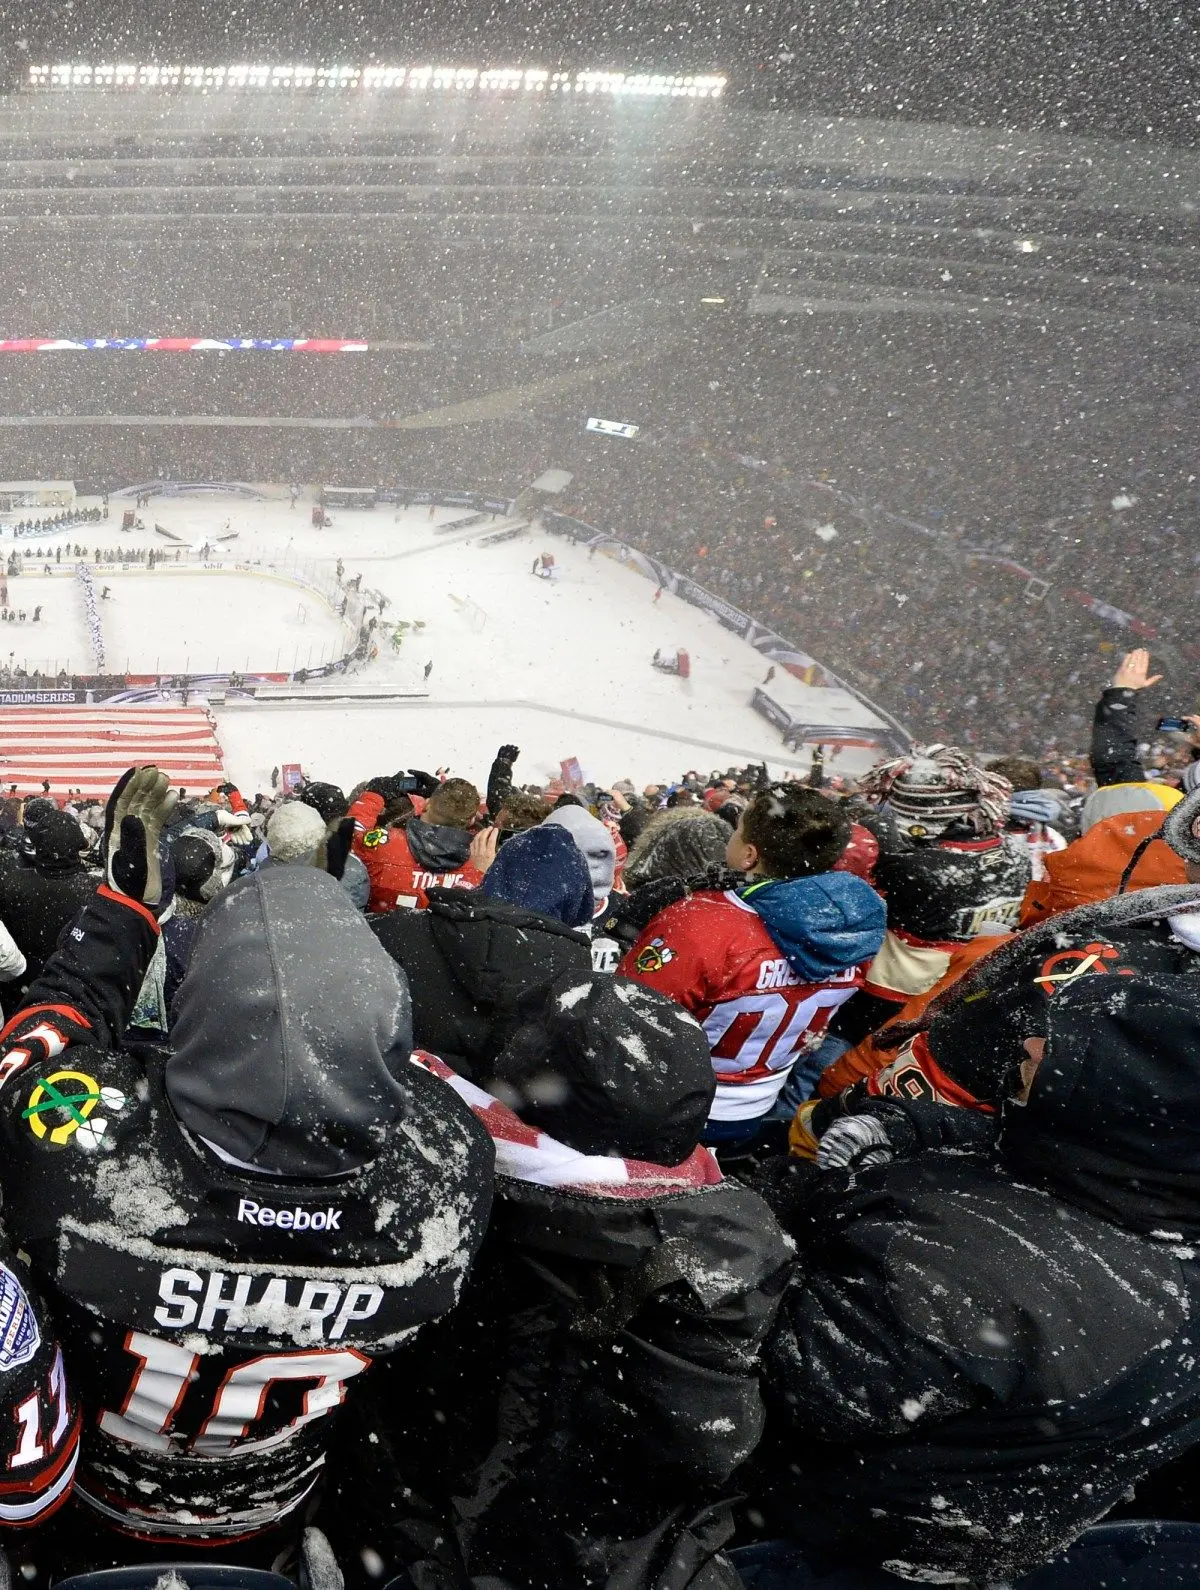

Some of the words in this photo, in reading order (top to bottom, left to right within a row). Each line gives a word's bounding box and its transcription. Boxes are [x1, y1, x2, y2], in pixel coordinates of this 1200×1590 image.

[237, 1198, 343, 1231] Reebok
[5, 1302, 25, 1347] SERIES
[153, 1267, 385, 1340] SHARP
[15, 1312, 29, 1346] CHICAGO
[97, 1331, 373, 1458] 10
